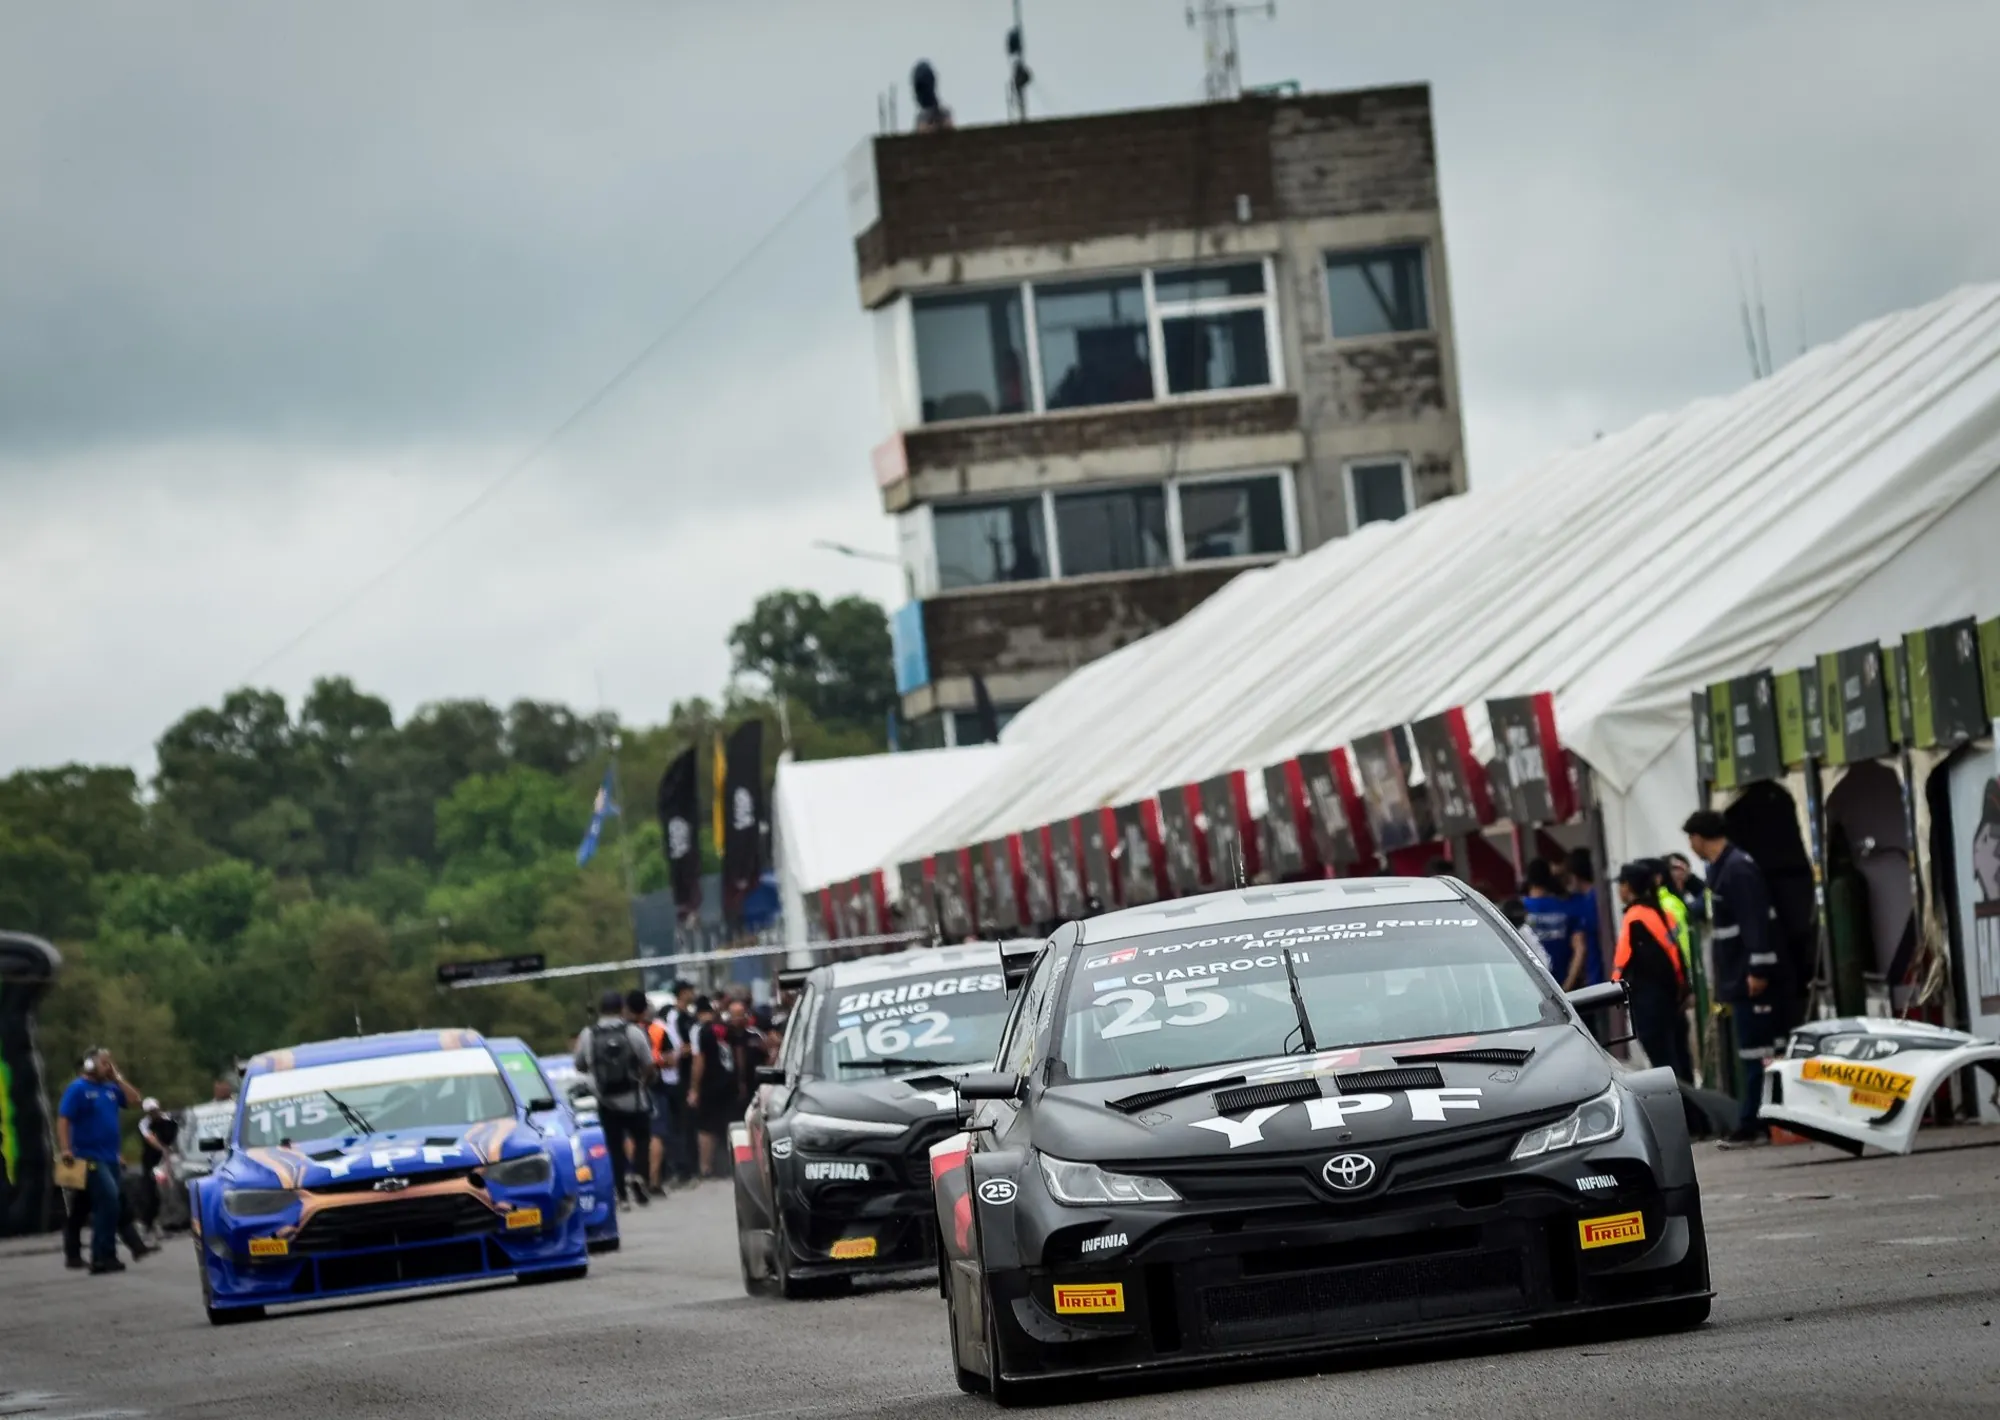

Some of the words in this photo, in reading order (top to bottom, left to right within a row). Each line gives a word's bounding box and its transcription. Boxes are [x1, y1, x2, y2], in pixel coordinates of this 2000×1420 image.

[1143, 933, 1254, 957] TOYOTA
[1262, 921, 1367, 939] GAZOO
[1376, 917, 1479, 929] Racing
[1242, 928, 1384, 950] Argentina
[1131, 952, 1311, 985] CIARROCHI
[1092, 977, 1230, 1039] 25
[829, 1011, 955, 1061] 162
[1819, 1063, 1913, 1094] MARTINEZ
[249, 1101, 329, 1133] 115
[1188, 1087, 1484, 1149] YPF
[312, 1145, 464, 1179] YPF
[805, 1162, 870, 1181] INFINIA
[985, 1183, 1012, 1198] 25
[1575, 1174, 1619, 1191] INFINIA
[1081, 1232, 1128, 1253] INFINIA
[1584, 1217, 1641, 1243] PIRELLI
[1058, 1288, 1117, 1308] PIRELLI
